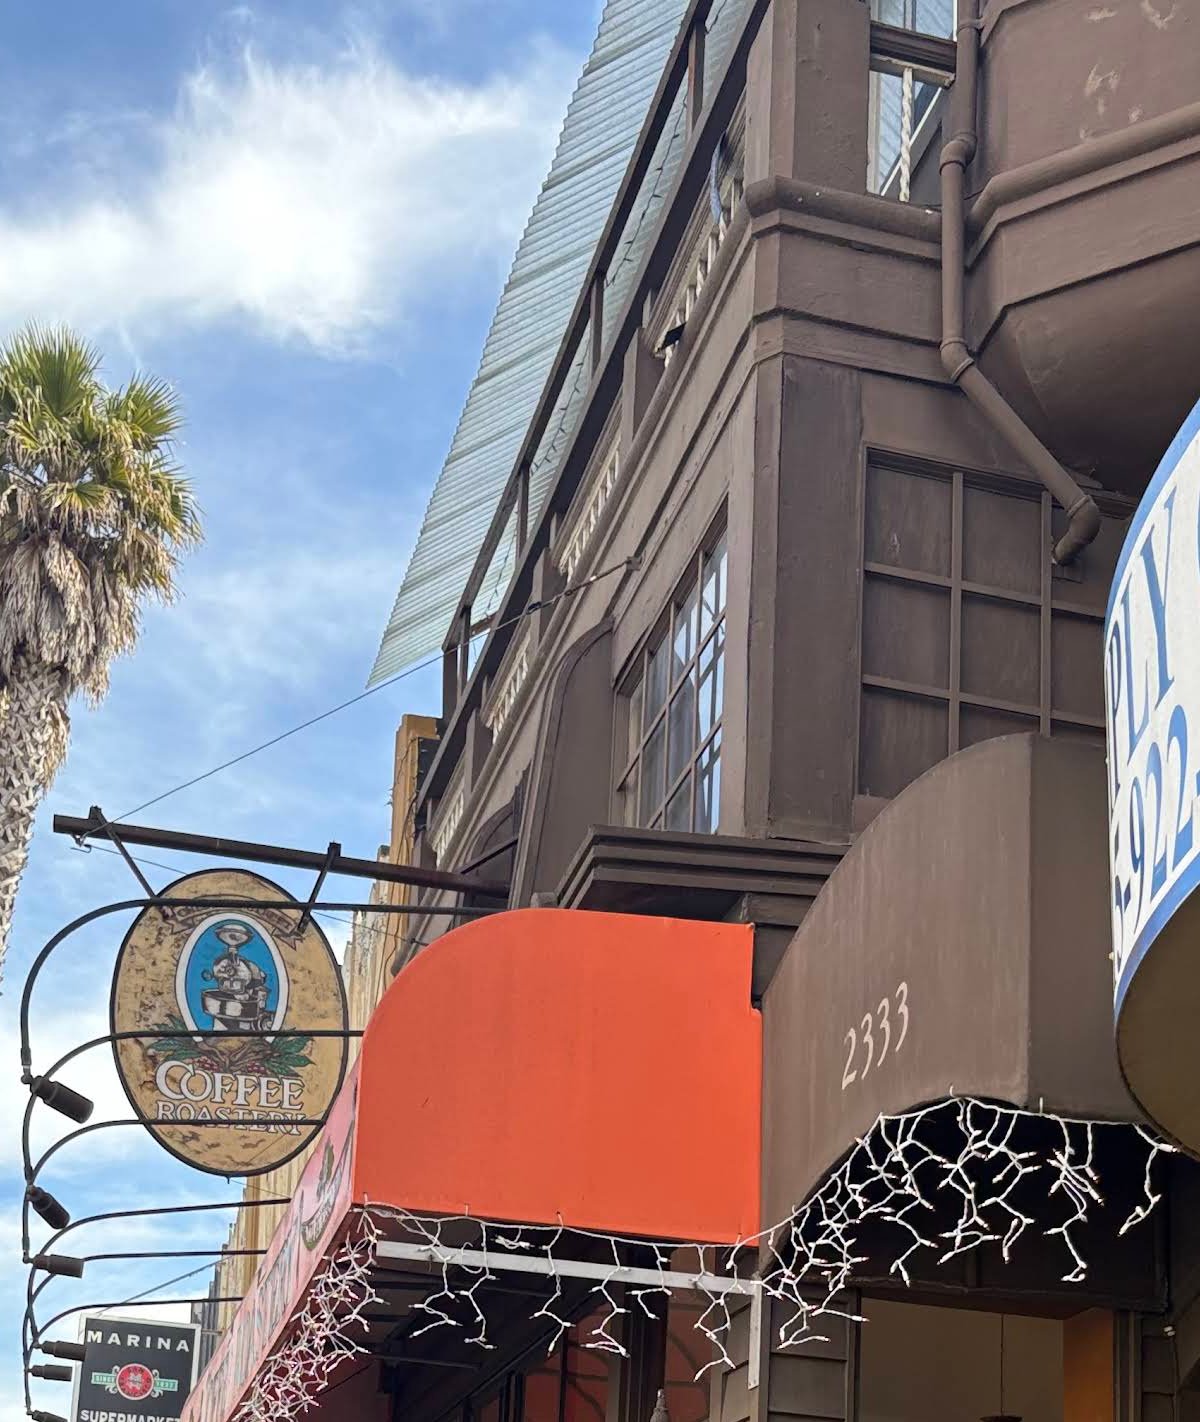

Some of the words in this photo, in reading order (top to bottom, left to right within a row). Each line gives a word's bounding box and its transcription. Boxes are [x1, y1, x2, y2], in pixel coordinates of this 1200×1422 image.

[1106, 485, 1177, 814] PLY
[842, 981, 909, 1090] 2333
[155, 1060, 305, 1110] COFFEE
[156, 1100, 307, 1135] ROASTERY
[87, 1330, 190, 1353] MARINA
